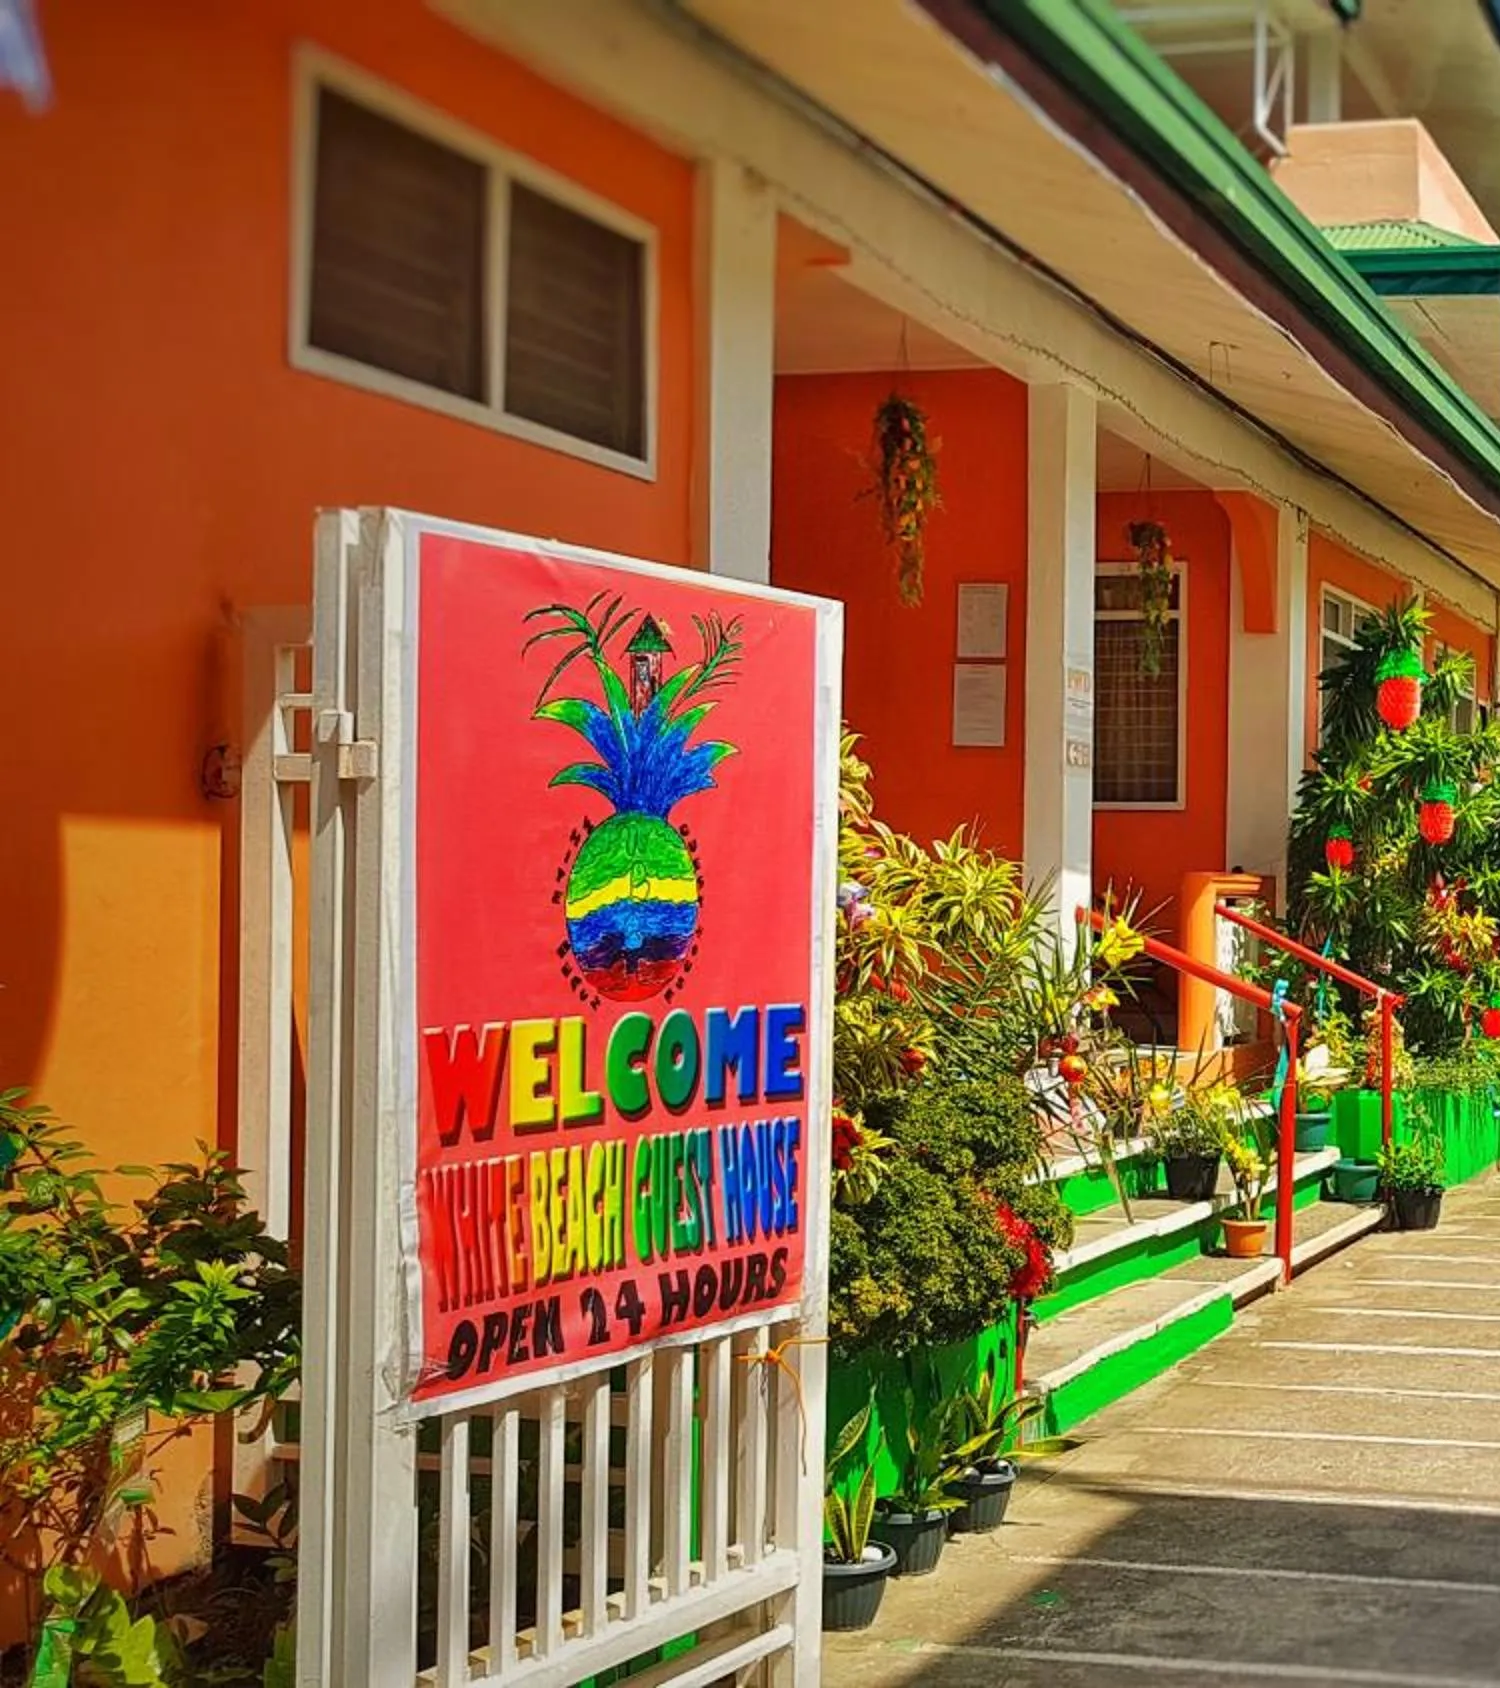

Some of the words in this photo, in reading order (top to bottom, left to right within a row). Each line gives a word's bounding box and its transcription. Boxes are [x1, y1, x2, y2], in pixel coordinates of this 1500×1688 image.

[422, 1004, 806, 1147] WELCOME
[421, 1153, 529, 1313] WHITE
[529, 1139, 626, 1284] BEACH
[631, 1127, 717, 1265] GUEST
[716, 1115, 799, 1244] HOUSE
[446, 1293, 565, 1381] OPEN
[579, 1279, 646, 1346] 24
[658, 1247, 789, 1321] HOURS
